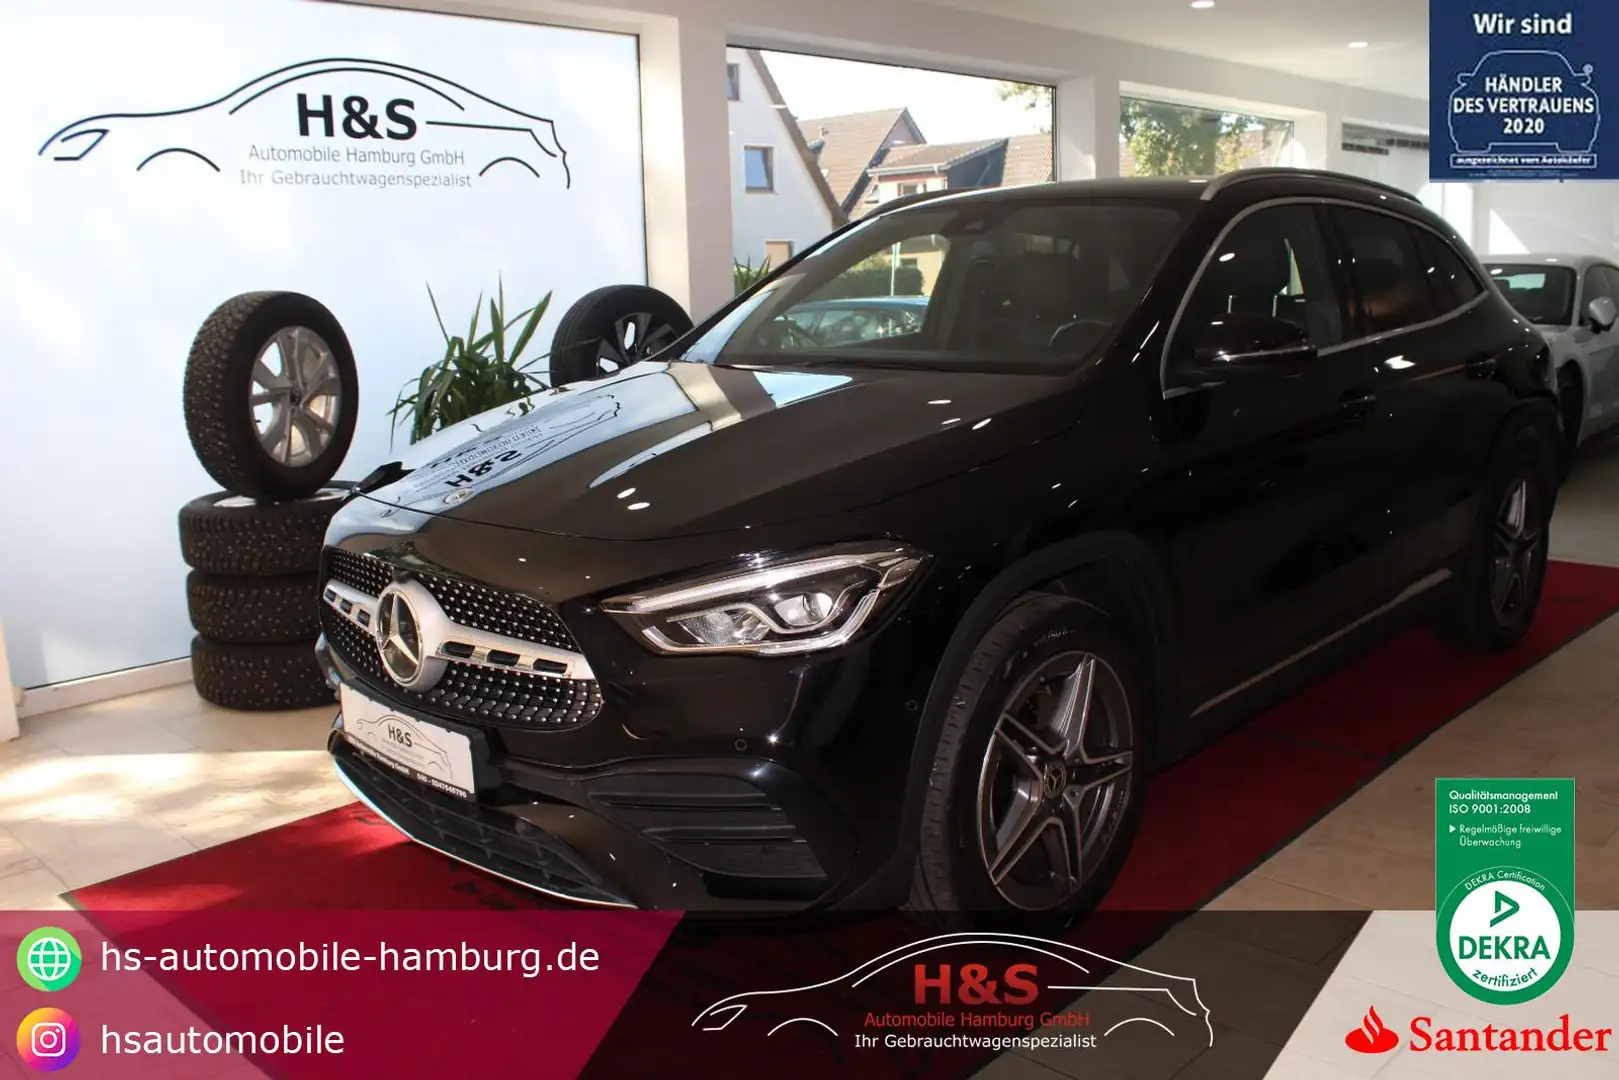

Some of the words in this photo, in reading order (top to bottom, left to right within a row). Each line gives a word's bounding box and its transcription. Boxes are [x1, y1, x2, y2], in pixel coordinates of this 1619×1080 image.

[297, 93, 417, 141] H&S
[249, 145, 341, 163] Automobile
[346, 148, 416, 167] Hamburg
[420, 150, 465, 166] GmbH
[240, 169, 265, 185] Ihr
[271, 169, 472, 190] Gebrauchtwagenspezialist
[387, 724, 412, 747] H&S
